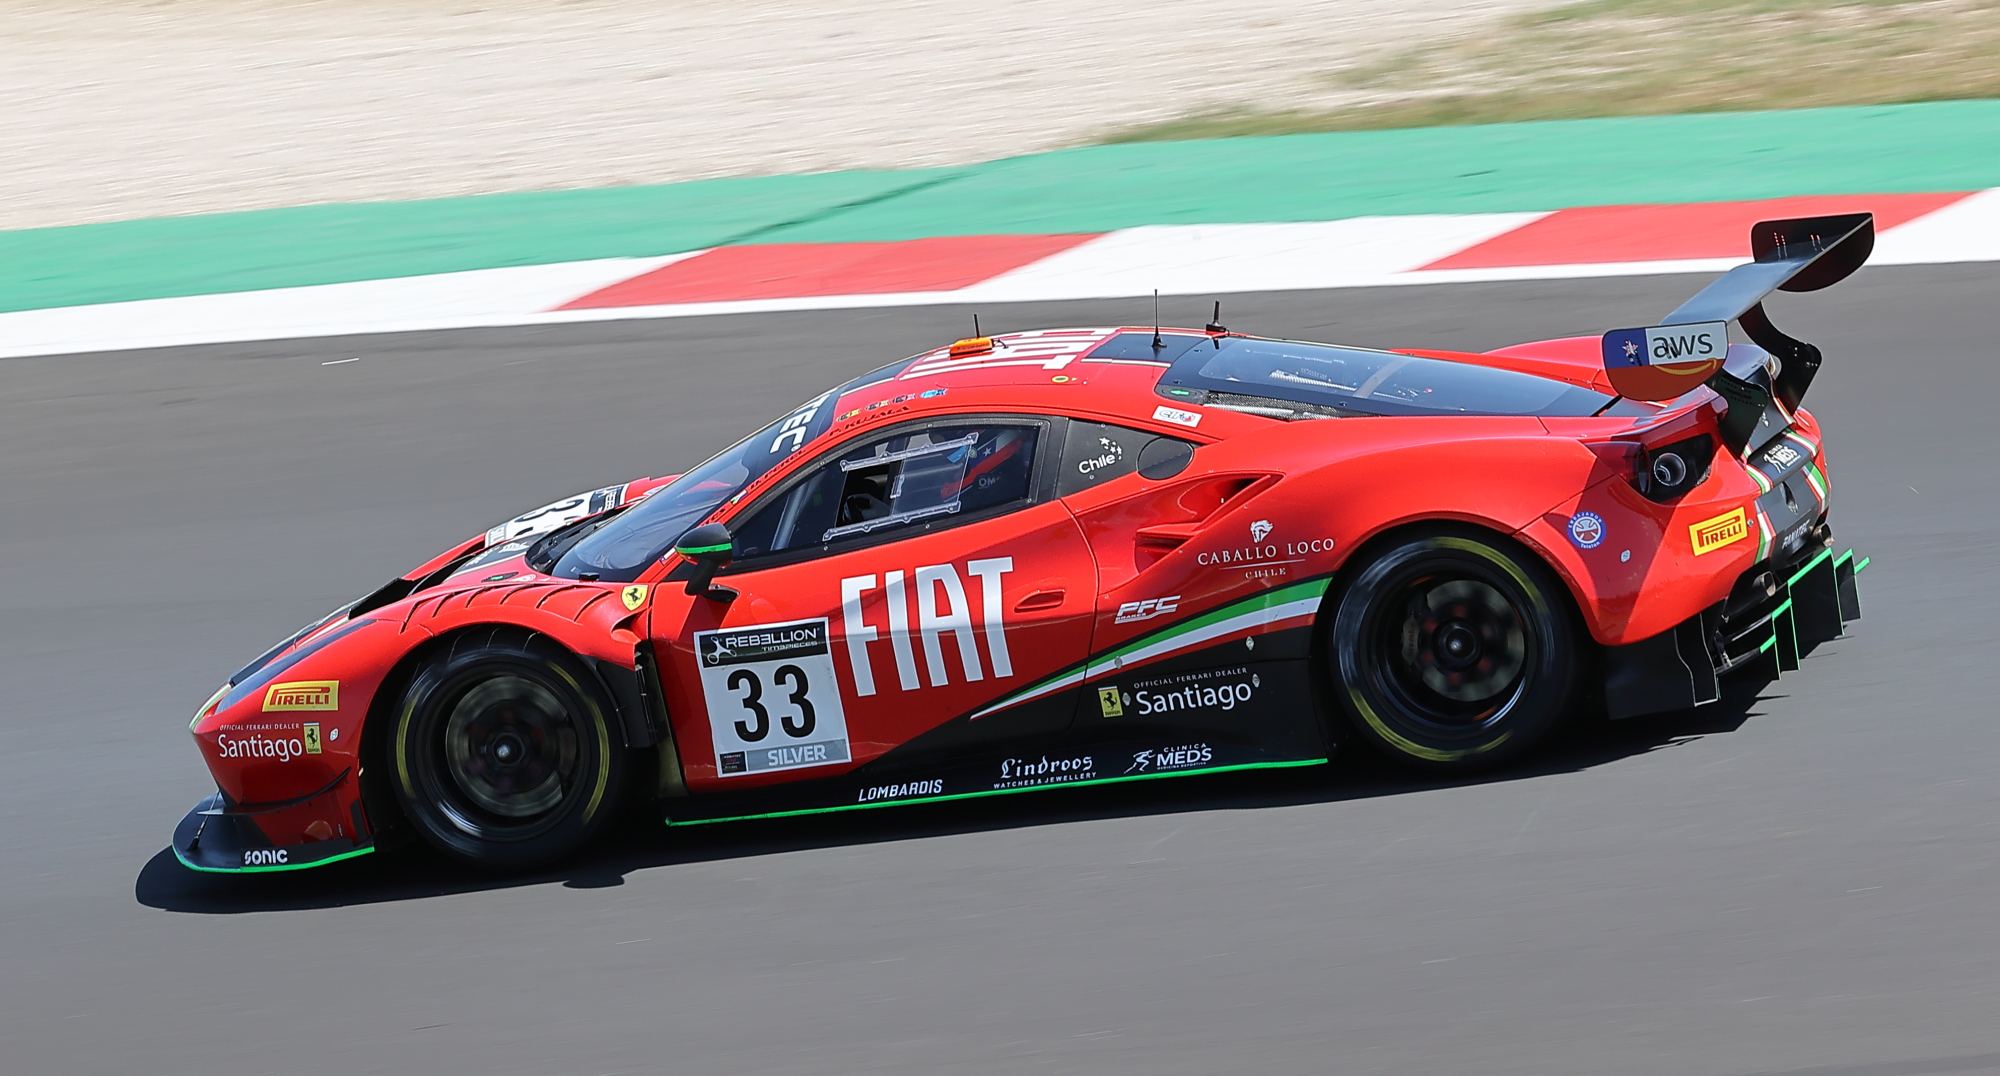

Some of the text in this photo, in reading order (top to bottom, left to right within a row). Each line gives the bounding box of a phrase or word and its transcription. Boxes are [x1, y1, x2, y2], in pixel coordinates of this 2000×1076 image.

[1653, 333, 1713, 358] aws
[1078, 454, 1116, 474] Chile
[1696, 514, 1742, 548] PIRELLI
[1197, 538, 1335, 565] CABALLO LOCO
[1245, 567, 1286, 579] CHILE
[1116, 595, 1181, 617] PFC
[841, 556, 1014, 697] FIAT
[725, 628, 817, 649] REBELLION
[1133, 667, 1248, 689] OFFICIAL FERRARI DEALER
[269, 686, 331, 706] PIRELLI
[727, 664, 817, 742] 33
[1136, 682, 1252, 715] Santiago
[274, 722, 300, 730] DEALER
[218, 733, 303, 762] Santiago
[767, 744, 827, 766] SILVER
[1156, 747, 1212, 767] MEDS
[1163, 742, 1207, 753] CLINICA
[1000, 755, 1093, 779] Lindroos
[858, 779, 943, 803] LOMBARDIS
[993, 779, 1035, 789] WATCHES
[1044, 771, 1097, 784] JEWELLERY
